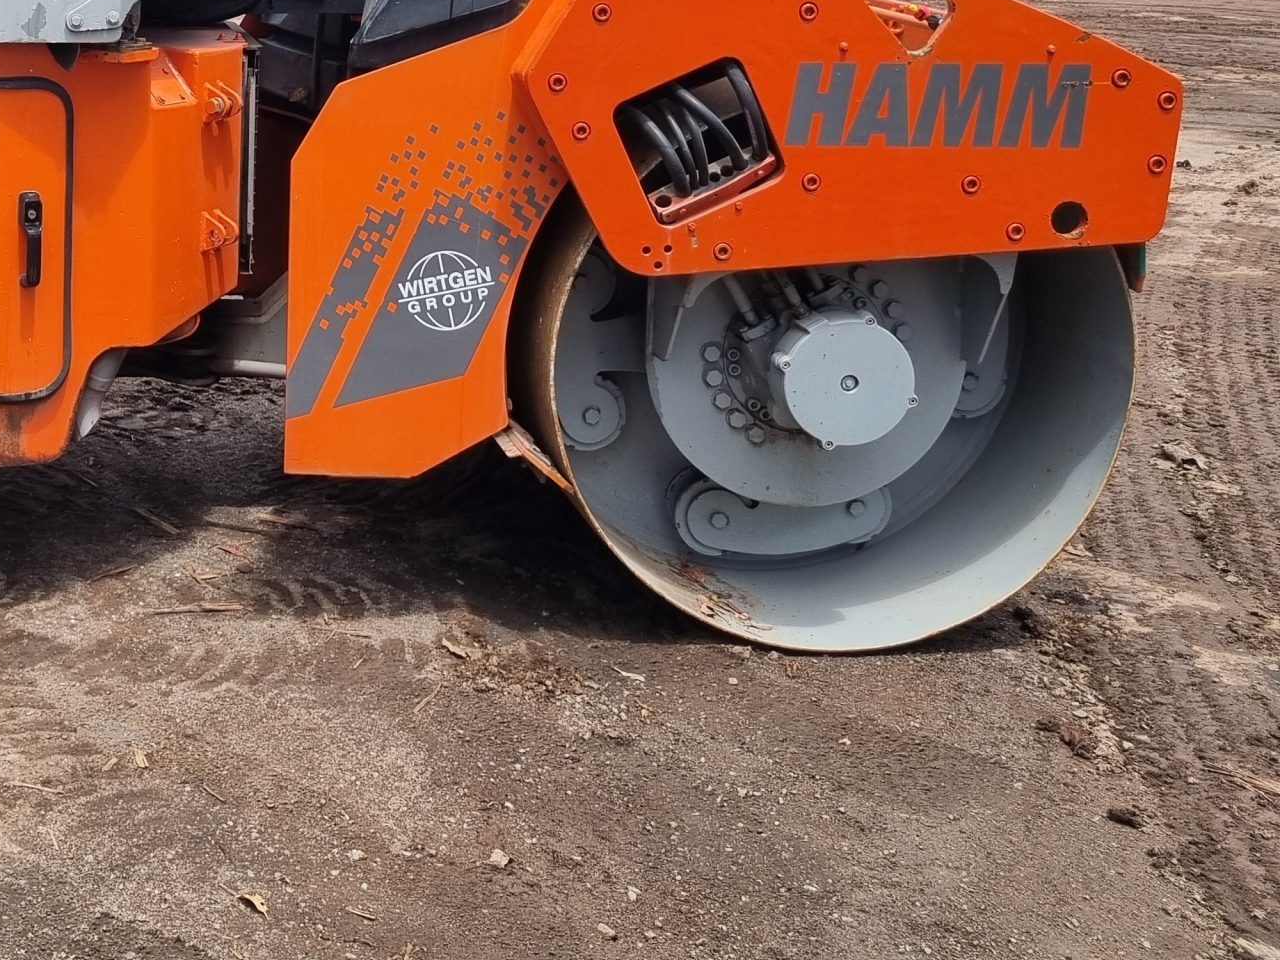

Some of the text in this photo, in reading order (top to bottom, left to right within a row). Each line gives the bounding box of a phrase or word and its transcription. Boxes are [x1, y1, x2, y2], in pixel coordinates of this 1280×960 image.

[784, 62, 1092, 149] HAMM
[398, 266, 493, 298] WIRTGEN
[407, 287, 489, 314] GROUP
